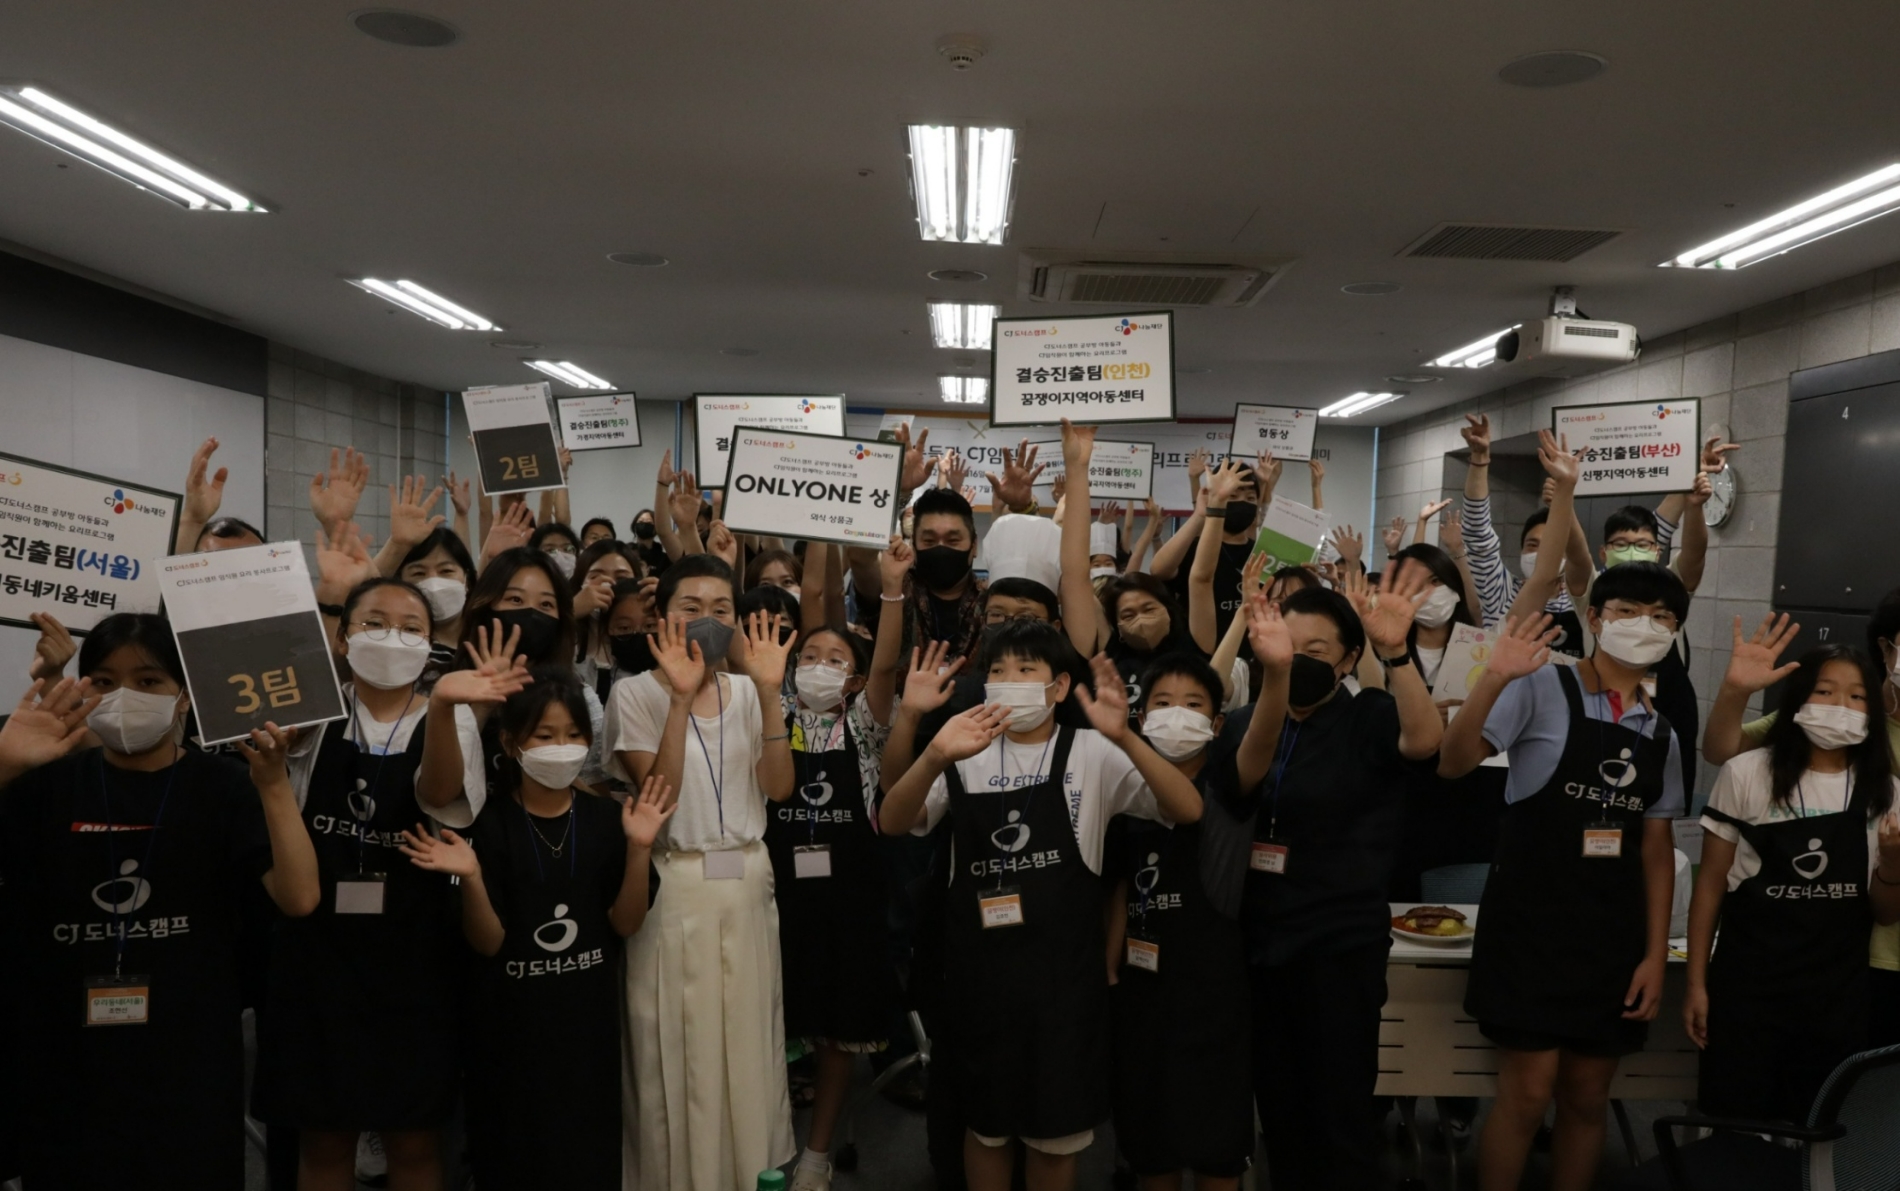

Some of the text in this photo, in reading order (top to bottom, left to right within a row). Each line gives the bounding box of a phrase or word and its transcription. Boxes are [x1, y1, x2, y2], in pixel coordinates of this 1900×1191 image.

[1014, 329, 1047, 337] 도너스캠프
[1016, 362, 1150, 383] 결승진출팀(인천)
[1021, 389, 1144, 406] 꿈쟁이지역아동센터
[1841, 406, 1849, 420] 4
[1258, 427, 1289, 440] 협동상
[499, 454, 540, 481] 2팀
[1582, 466, 1669, 482] 신평지역아동센터
[735, 474, 891, 508] ONLYONE 상
[104, 496, 166, 518] CJ 나눔재단
[51, 508, 76, 521] 공부방
[77, 513, 110, 528] 아동들과
[810, 512, 854, 526] 외식 상품권
[33, 517, 66, 532] 함께하는
[68, 525, 115, 542] 요리프로그램
[0, 534, 140, 581] 진출팀(서울)
[0, 573, 117, 610] 동네키움센터
[1818, 627, 1830, 641] 17
[227, 665, 301, 714] 3팀
[988, 776, 1010, 787] GO
[1564, 782, 1586, 799] CJ
[313, 814, 336, 835] CJ
[778, 808, 853, 823] CJ 도너스캠프
[970, 849, 1062, 877] CJ 도너스캠프
[1765, 882, 1858, 899] CJ 도너스캠프
[53, 915, 191, 945] CJ 도너스캠프
[506, 948, 604, 980] CJ 도너스캠프
[93, 996, 144, 1006] 우리동네(서울)
